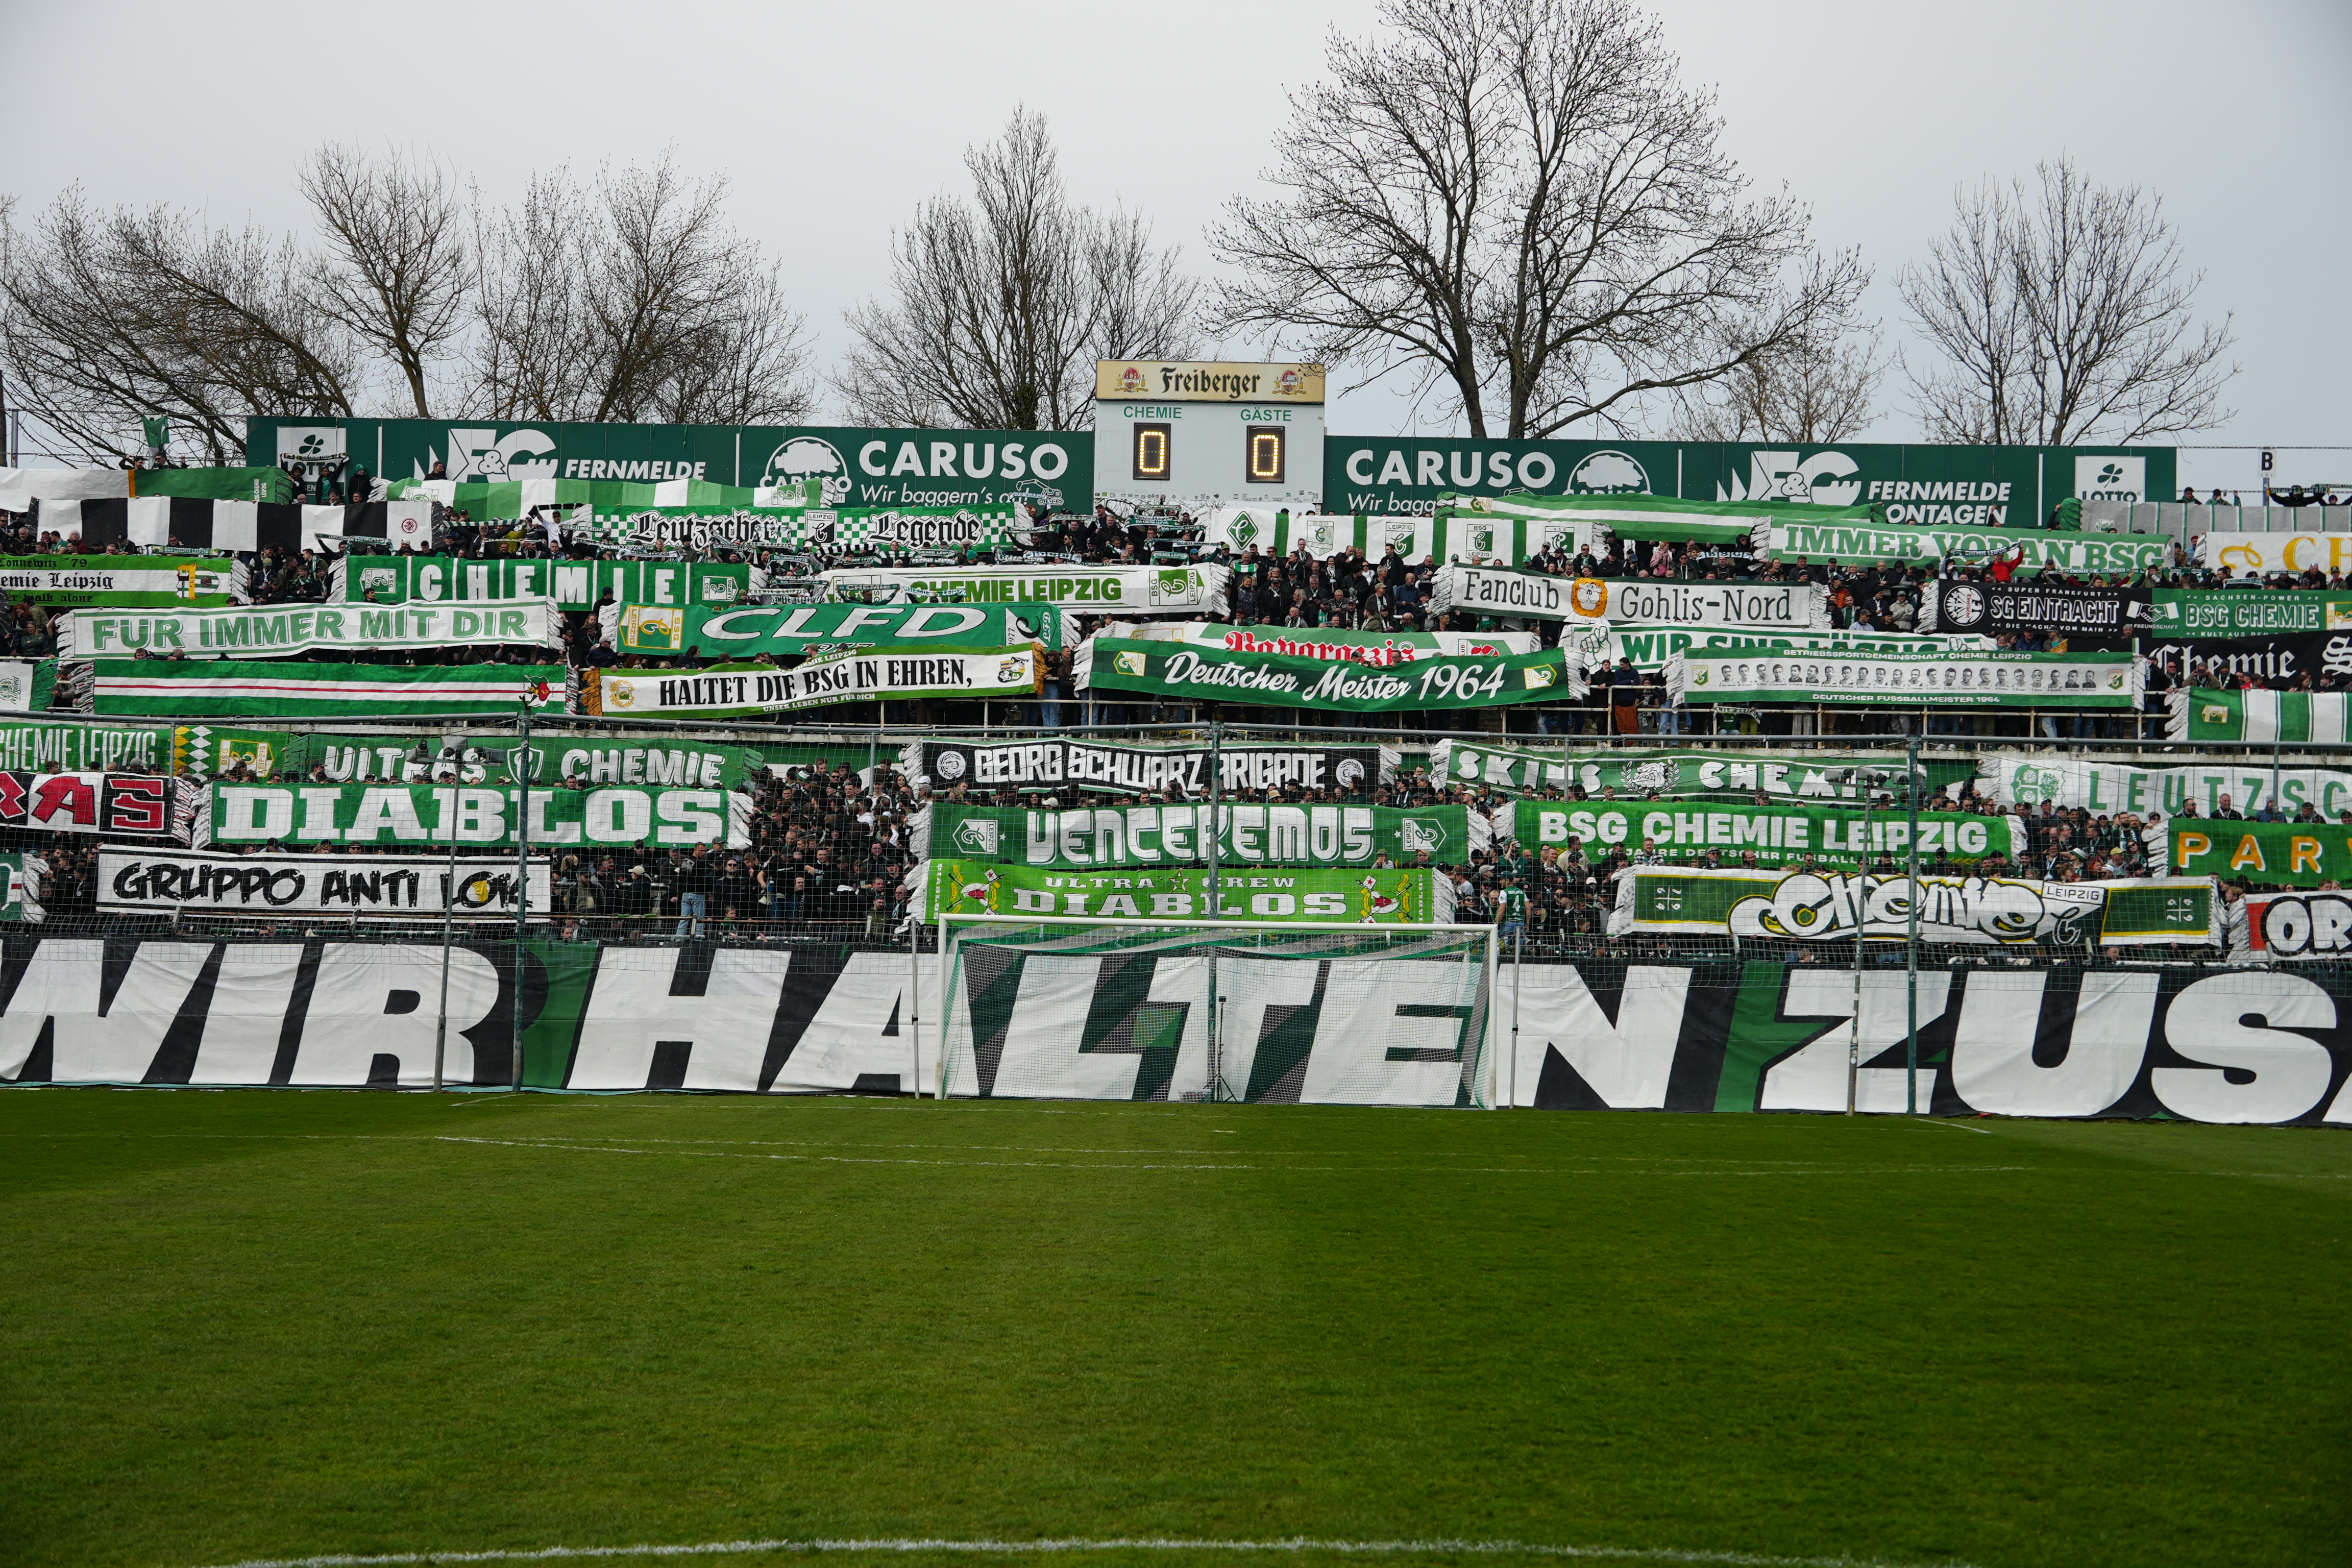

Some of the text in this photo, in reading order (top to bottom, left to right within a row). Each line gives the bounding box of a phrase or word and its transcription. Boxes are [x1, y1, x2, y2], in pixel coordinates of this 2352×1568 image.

[1160, 367, 1261, 399] Freiberger
[1123, 406, 1182, 419] CHEMIE
[1240, 408, 1292, 421] GÄSTE
[859, 440, 1068, 480] CARUSO
[1140, 431, 1165, 473] 0
[1253, 434, 1278, 476] 0
[2261, 452, 2273, 471] B
[565, 459, 706, 481] FERNMELDE
[1346, 449, 1555, 489] CARUSO
[861, 482, 993, 506] Wir baggern's
[1348, 493, 1383, 510] Wir
[1868, 481, 2012, 501] FERNMELDE
[1886, 504, 2008, 525] ONTAGEN
[868, 510, 982, 549] Legende
[1784, 525, 1922, 558] IMMER
[2084, 541, 2165, 570] BSG
[1988, 547, 2007, 555] LEIPZIG
[50, 571, 113, 590] Leipzig
[902, 585, 967, 596] CHEMIE LEIPZIG
[910, 578, 1121, 603] CHEMIE LEIPZIG
[60, 594, 93, 603] alone
[1464, 571, 1792, 622] Fanclub Gohlis-Nord
[1991, 596, 2120, 624] SG EINTRACHT
[93, 609, 529, 650] FÜR IMMER MIT DIR
[673, 617, 681, 641] BSG
[701, 606, 987, 640] CLFD
[2185, 604, 2319, 629] BSG CHEMIE
[825, 649, 857, 661] LEIPZIG
[1783, 649, 1945, 660] BETRIEBSSPORTGEMEINSCHAFT
[10, 676, 21, 705] Mitglied
[659, 677, 749, 706] HALTET
[756, 674, 797, 702] DIE
[802, 663, 849, 696] BSG
[855, 660, 878, 688] IN
[887, 659, 972, 688] EHREN,
[1164, 651, 1506, 702] Deutscher Meister 1964
[763, 703, 790, 712] UNSER
[792, 699, 818, 708] LEBEN
[820, 696, 839, 704] NUR
[841, 693, 855, 701] FÜR
[1876, 695, 1973, 703] FUSSBALLMEISTER
[80, 728, 157, 771] LEIPZIG
[258, 743, 267, 777] LEIPZIG
[561, 748, 726, 788] CHEMIE
[974, 743, 1063, 783] GEORG
[1067, 745, 1205, 792] SCHWARZ
[1456, 750, 1602, 794] SKINS
[217, 786, 722, 844] DIABLOS
[1539, 811, 1987, 854] BSG CHEMIE LEIPZIG
[2177, 832, 2352, 873] PAR
[113, 861, 305, 906] GRUPPO
[321, 869, 420, 908] ANTI
[2046, 887, 2100, 900] LEIPZIG
[1013, 888, 1347, 916] DIABLOS
[568, 944, 1694, 1109] HALTEN
[1760, 968, 2352, 1123] ZUS
